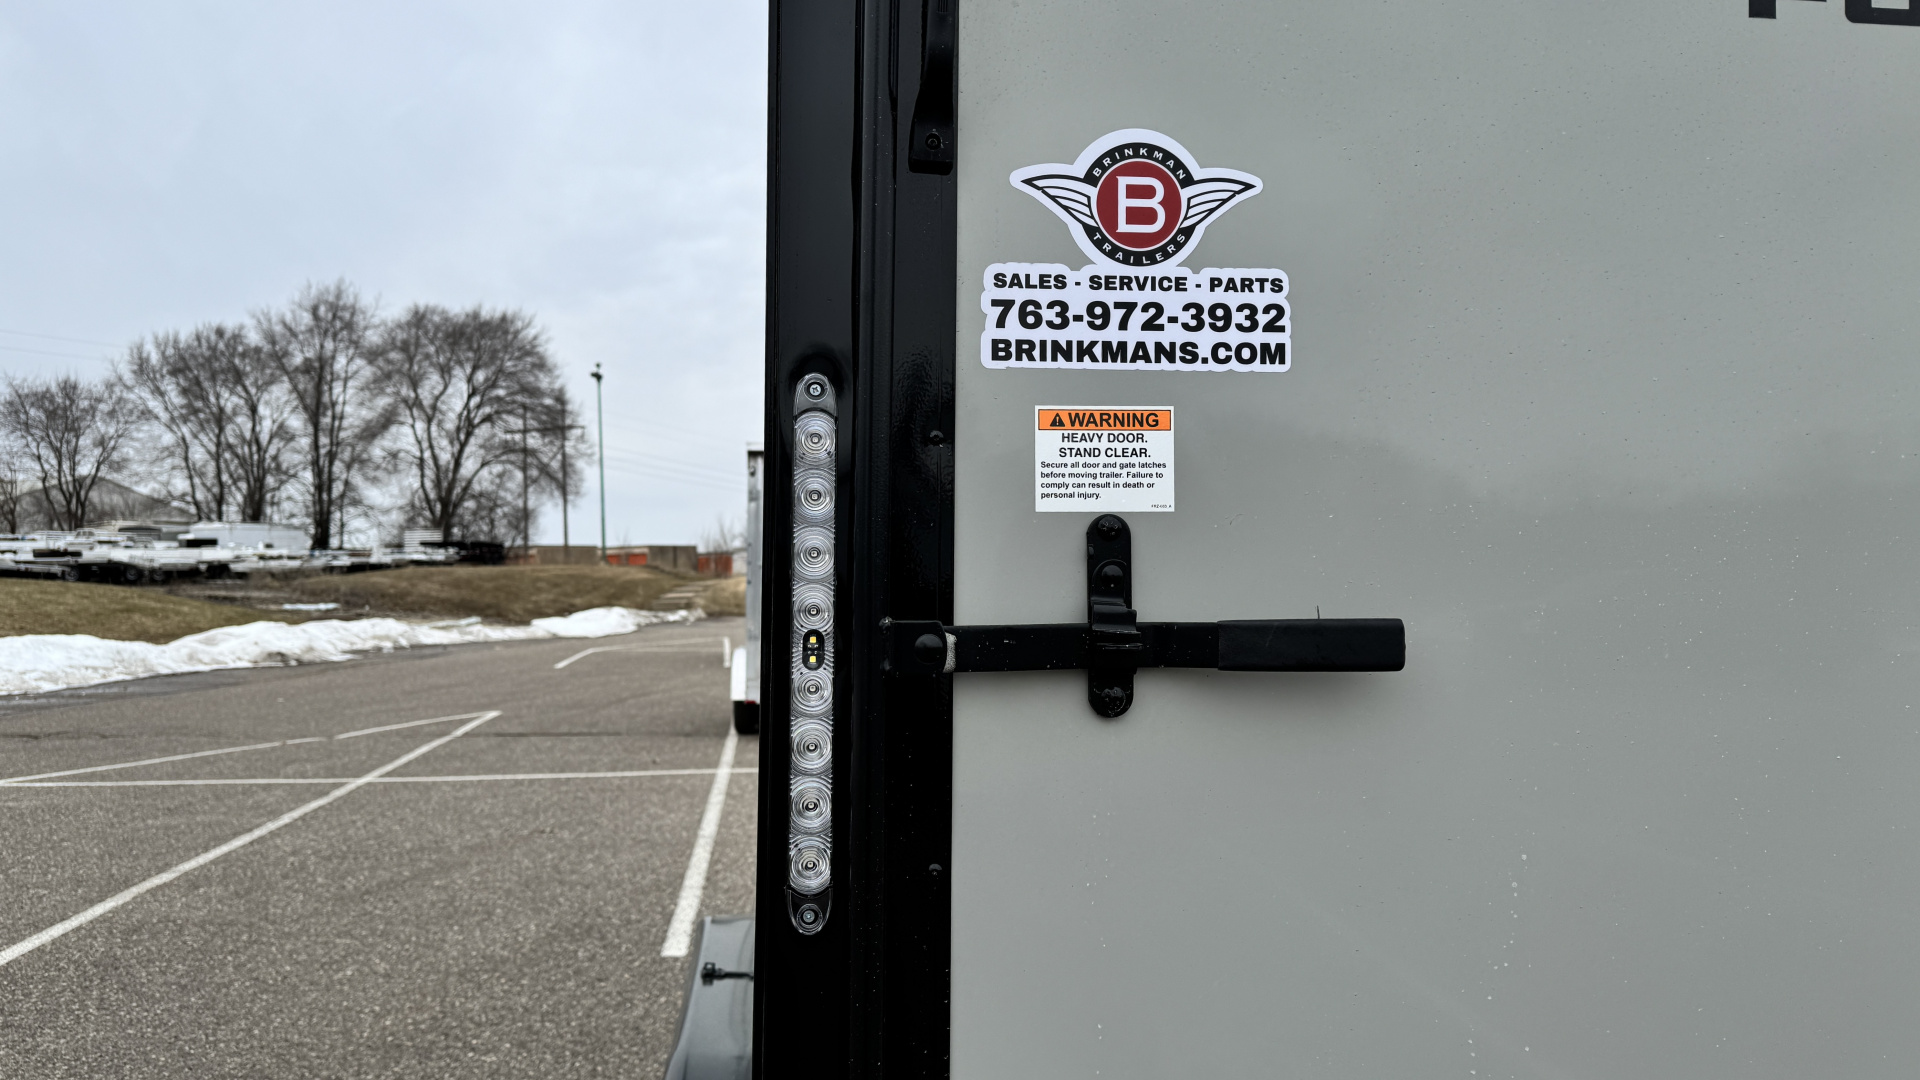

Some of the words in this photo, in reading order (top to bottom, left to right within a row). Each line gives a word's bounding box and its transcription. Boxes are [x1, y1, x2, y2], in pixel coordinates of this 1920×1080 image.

[1093, 147, 1186, 180] BRINKMAN
[1116, 176, 1165, 233] B
[1093, 233, 1186, 264] TRAILERS
[993, 273, 1067, 289] SALES
[1089, 275, 1187, 292] SERVICE
[1210, 277, 1283, 293] PARTS
[990, 299, 1286, 333] 763-972-3932
[991, 339, 1286, 365] BRINKMANS.COM
[1068, 413, 1159, 428] WARNING
[1062, 433, 1103, 443] HEAVY
[1107, 433, 1148, 443] DOOR.
[1059, 448, 1101, 457] STAND
[1105, 448, 1151, 457] CLEAR.
[1068, 472, 1097, 480] moving
[1119, 462, 1136, 470] gate
